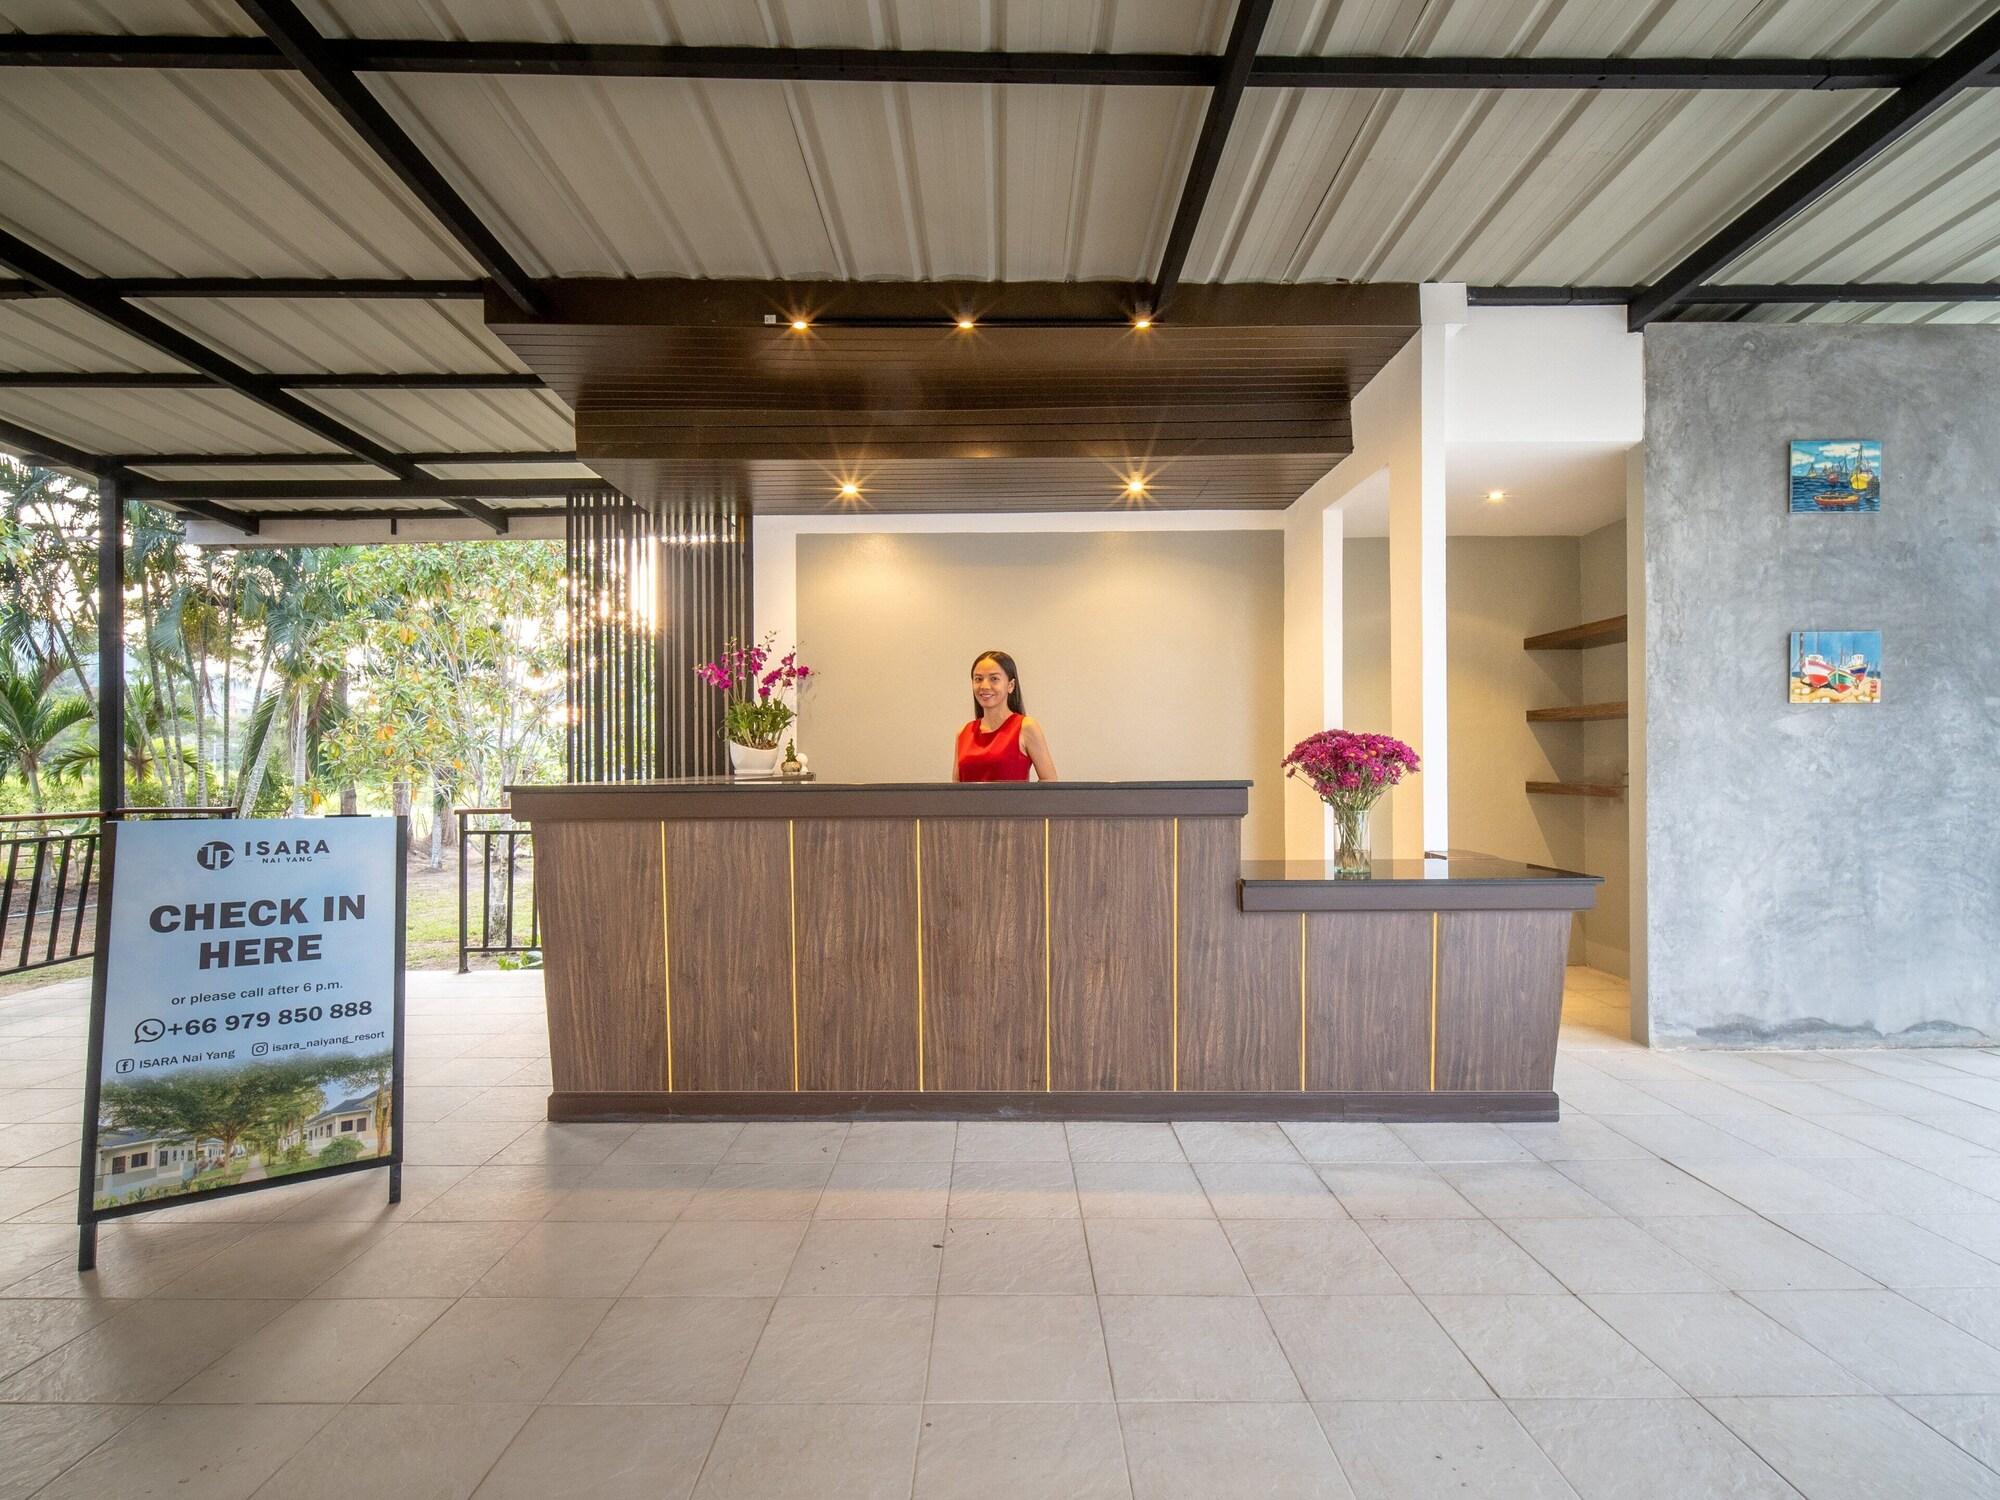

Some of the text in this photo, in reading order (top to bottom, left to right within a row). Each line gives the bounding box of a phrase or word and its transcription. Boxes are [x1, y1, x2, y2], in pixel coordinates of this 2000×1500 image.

[245, 839, 331, 857] ISARA
[149, 894, 366, 933] CHECK IN
[199, 934, 323, 970] HERE
[171, 981, 344, 1006] or please call after 6 p.m.
[167, 1000, 372, 1036] +66 979 850 888
[272, 1031, 385, 1051] isara_naiyang_resort
[139, 1050, 235, 1069] ISARA Nai Yang
